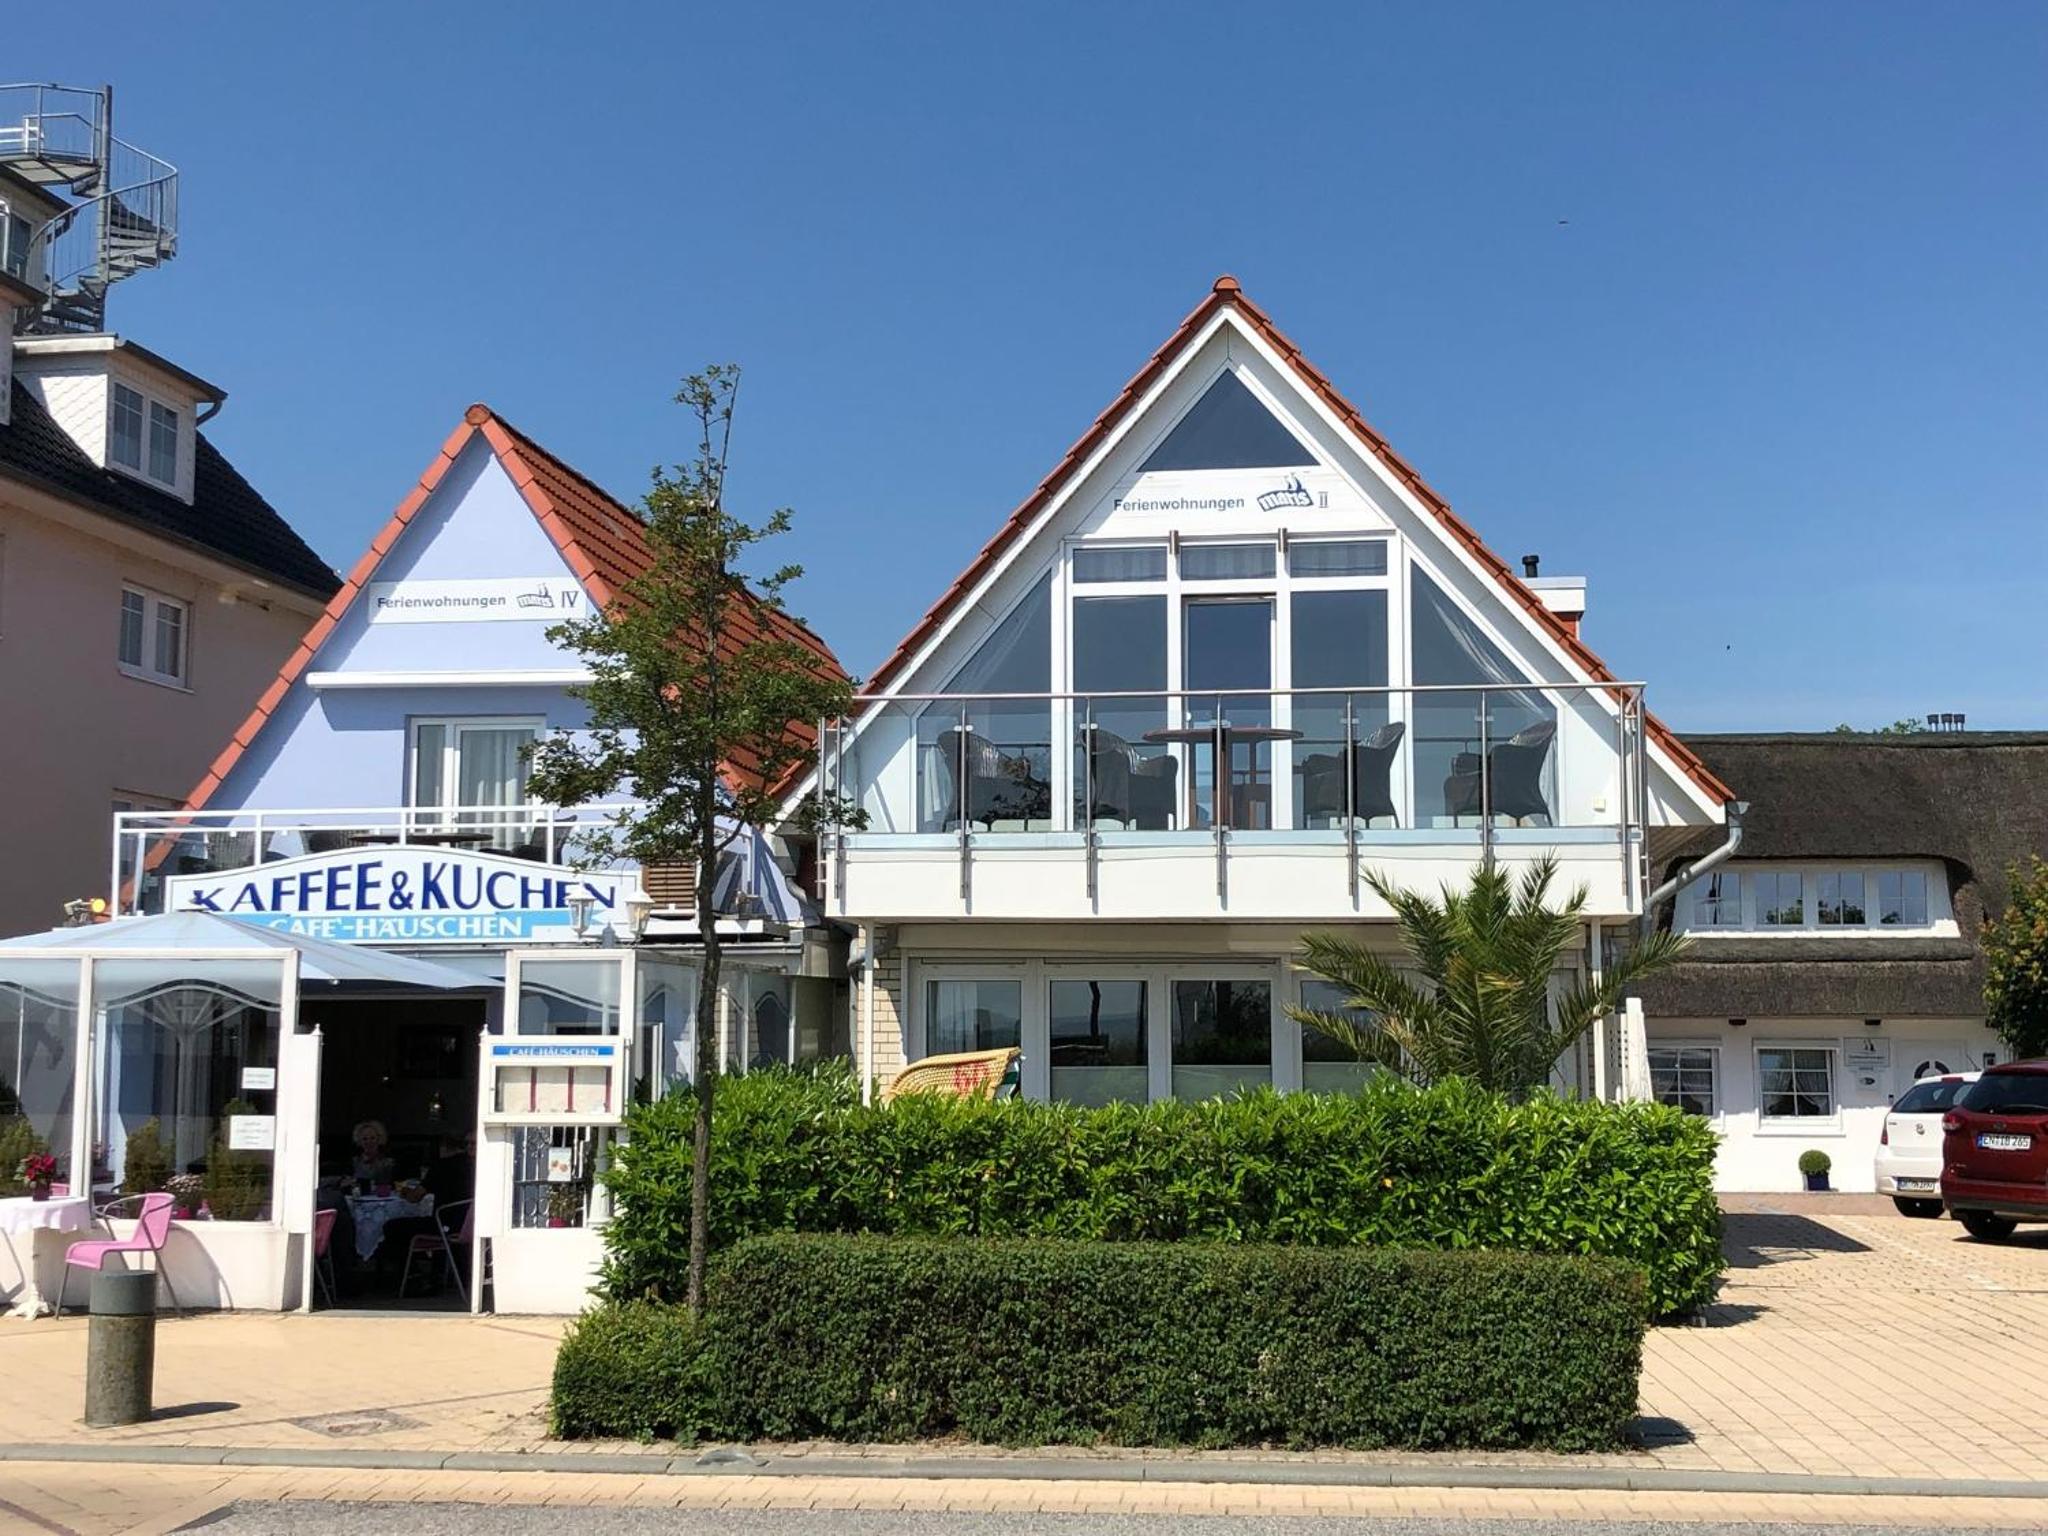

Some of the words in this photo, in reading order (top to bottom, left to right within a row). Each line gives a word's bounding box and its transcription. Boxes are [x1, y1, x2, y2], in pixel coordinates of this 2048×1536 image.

[1113, 497, 1245, 512] Ferienwohnungen
[377, 596, 506, 609] Ferienwohnungen
[561, 590, 579, 608] IV
